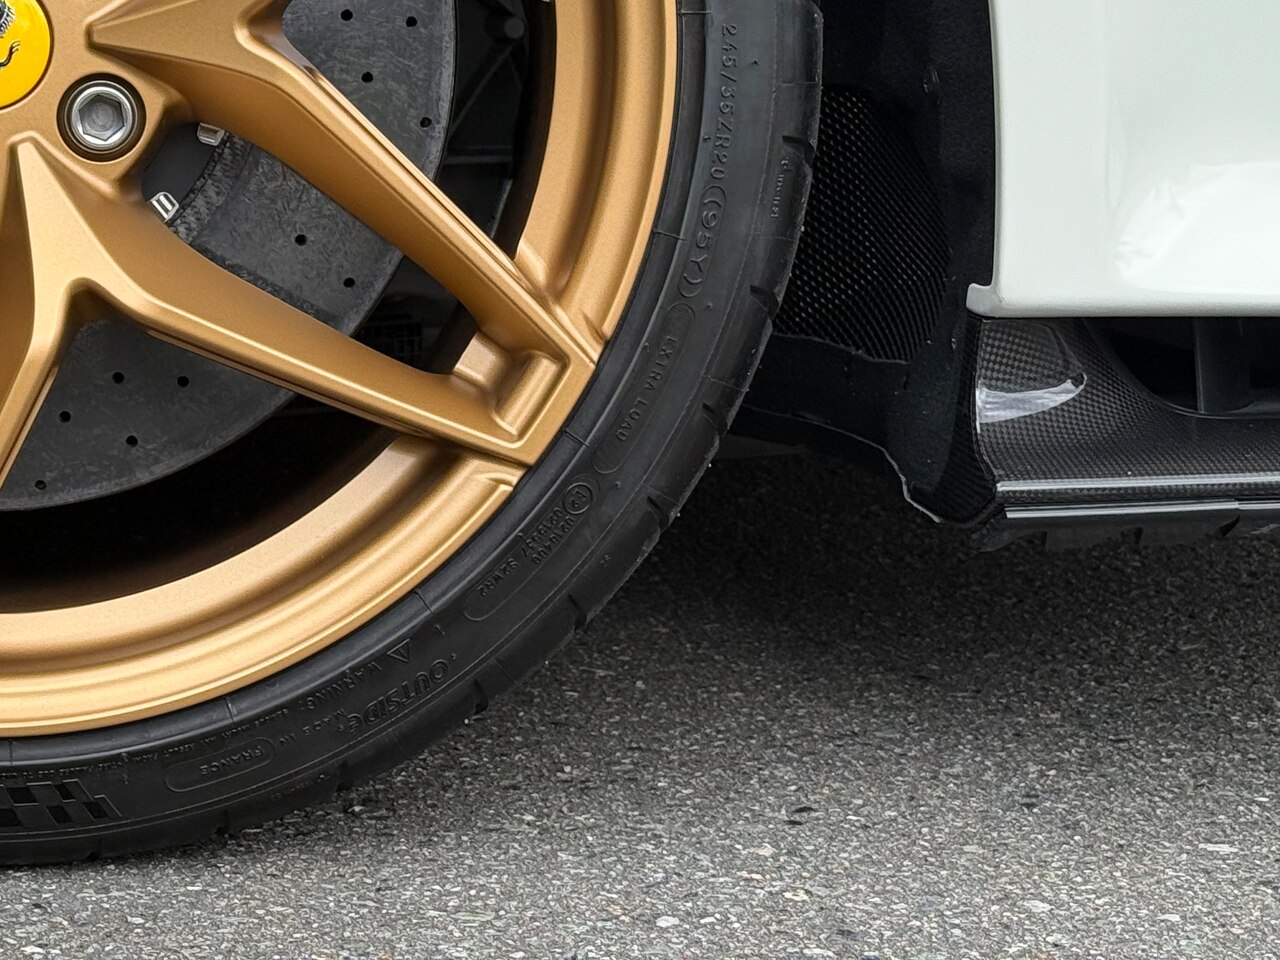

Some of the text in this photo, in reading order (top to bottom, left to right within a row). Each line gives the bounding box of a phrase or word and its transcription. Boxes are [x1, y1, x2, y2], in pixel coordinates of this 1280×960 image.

[709, 24, 738, 180] 245/35ZR20
[613, 397, 647, 444] LOAD
[197, 745, 265, 776] FRANCE
